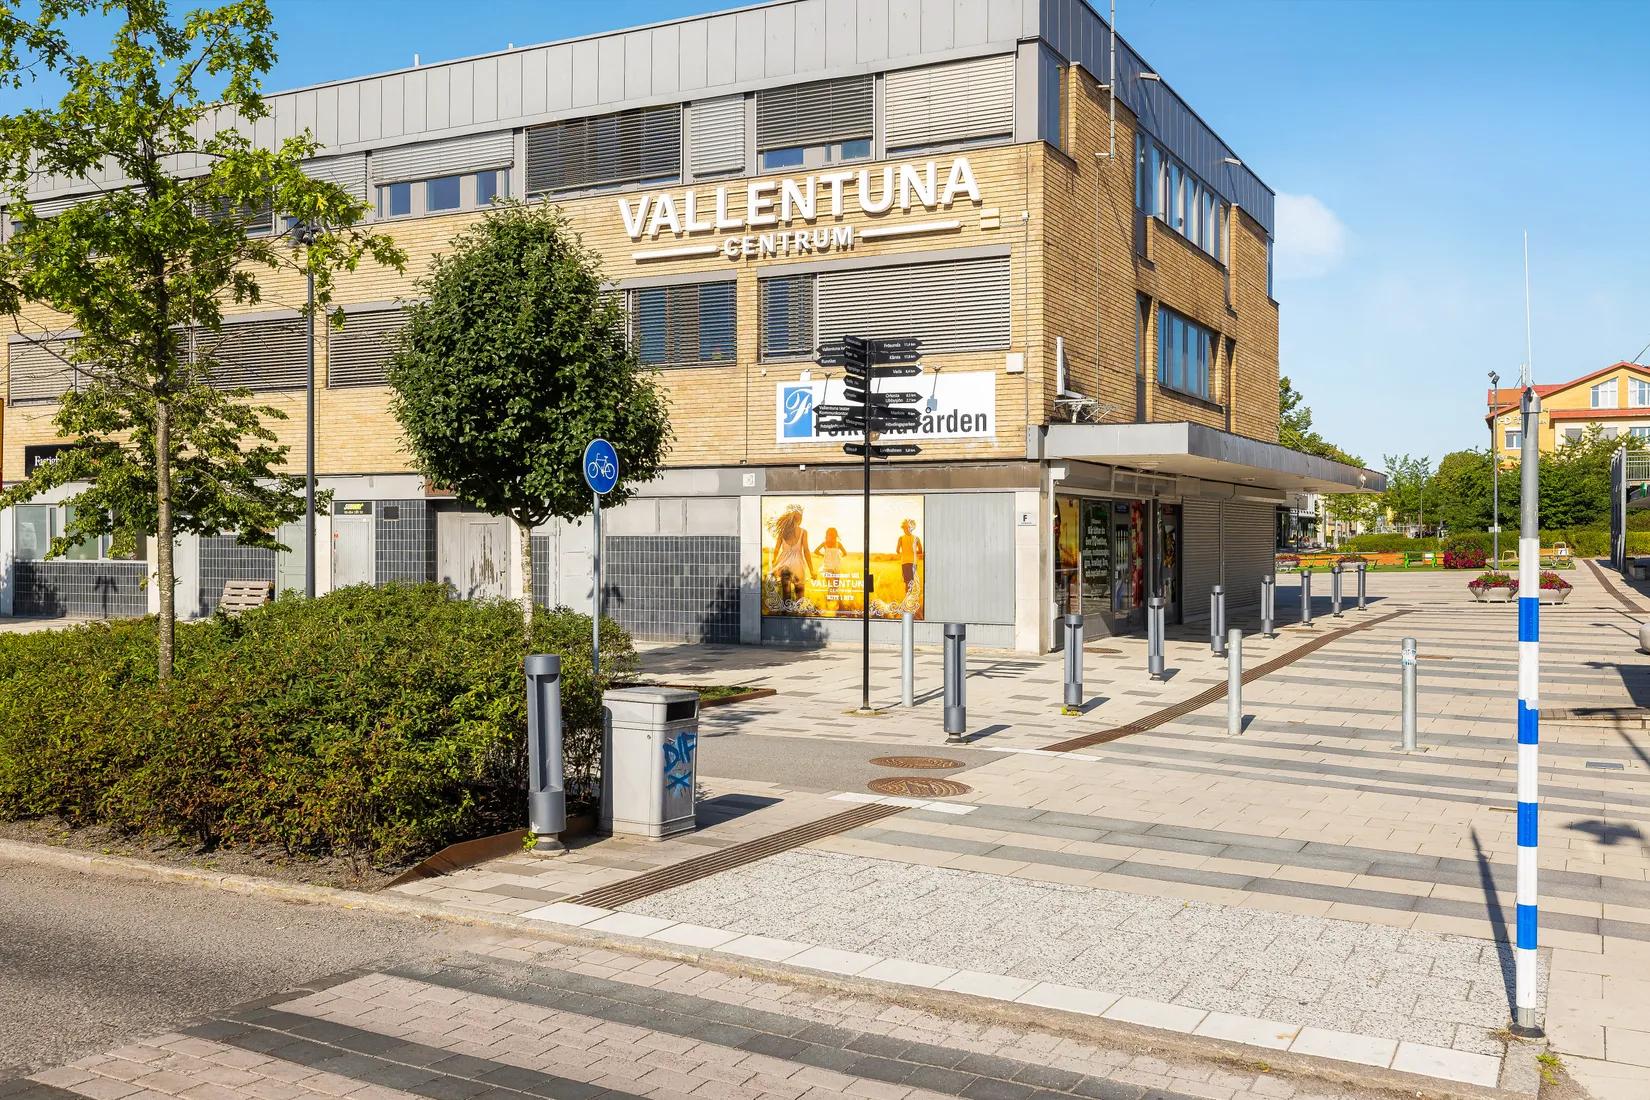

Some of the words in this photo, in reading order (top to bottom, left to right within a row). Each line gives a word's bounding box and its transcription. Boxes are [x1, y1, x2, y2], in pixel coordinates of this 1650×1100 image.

[617, 157, 983, 239] VALLENTUNA
[723, 225, 856, 258] CENTRUM
[1022, 514, 1028, 522] F
[811, 579, 865, 588] VALLENTUN
[662, 732, 697, 773] DIF
